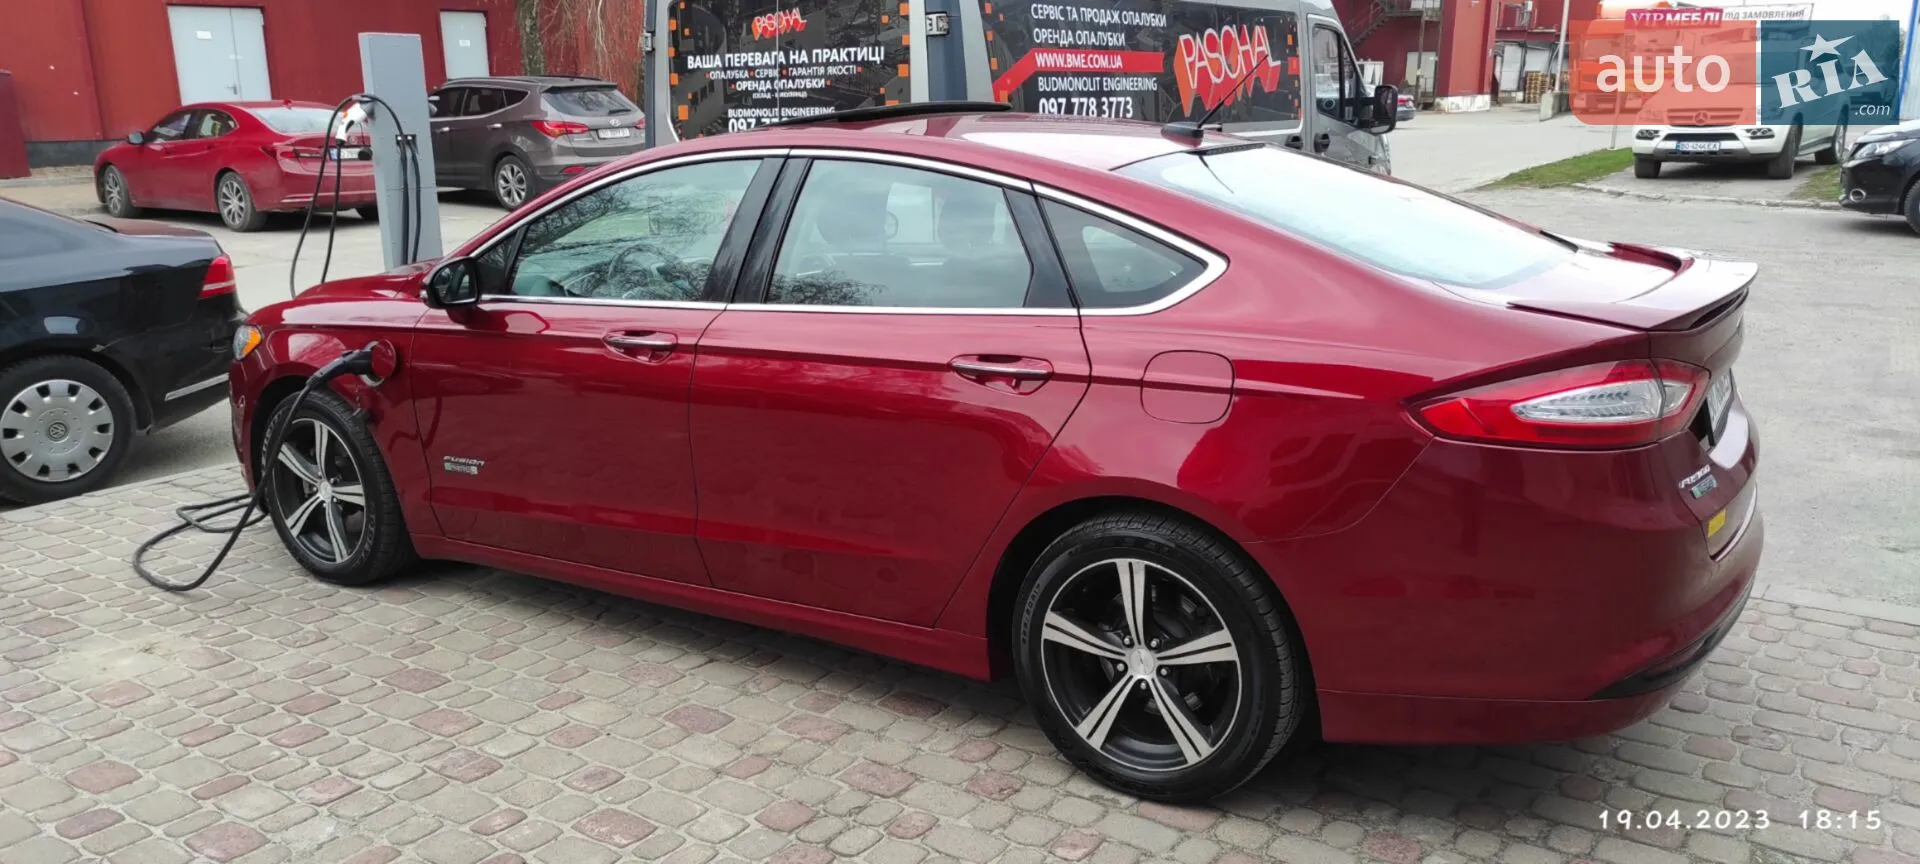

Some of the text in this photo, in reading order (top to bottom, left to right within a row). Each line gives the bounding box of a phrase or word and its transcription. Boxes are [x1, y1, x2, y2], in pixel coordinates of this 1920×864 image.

[753, 7, 807, 36] PASCHAL
[1031, 4, 1167, 27] СЕРВІС ТА ПРОДАЖ ОПАЛУБКИ
[1033, 28, 1126, 48] ОРЕНДА ОПАЛУБКИ
[687, 46, 885, 69] ВАША ПЕРЕВАГА НА ПРАКТИЦІ
[1035, 52, 1123, 68] WWW.BME.COM.UA
[1179, 24, 1281, 90] PASCHAL
[827, 66, 857, 75] ЯКОСТІ
[736, 79, 825, 92] ОРЕНДА ОПАЛУБКИ
[1038, 77, 1158, 91] BUDMONOLIT ENGINEERING
[728, 109, 779, 118] BUDMONOLIT
[1039, 96, 1134, 118] 097 778 3773
